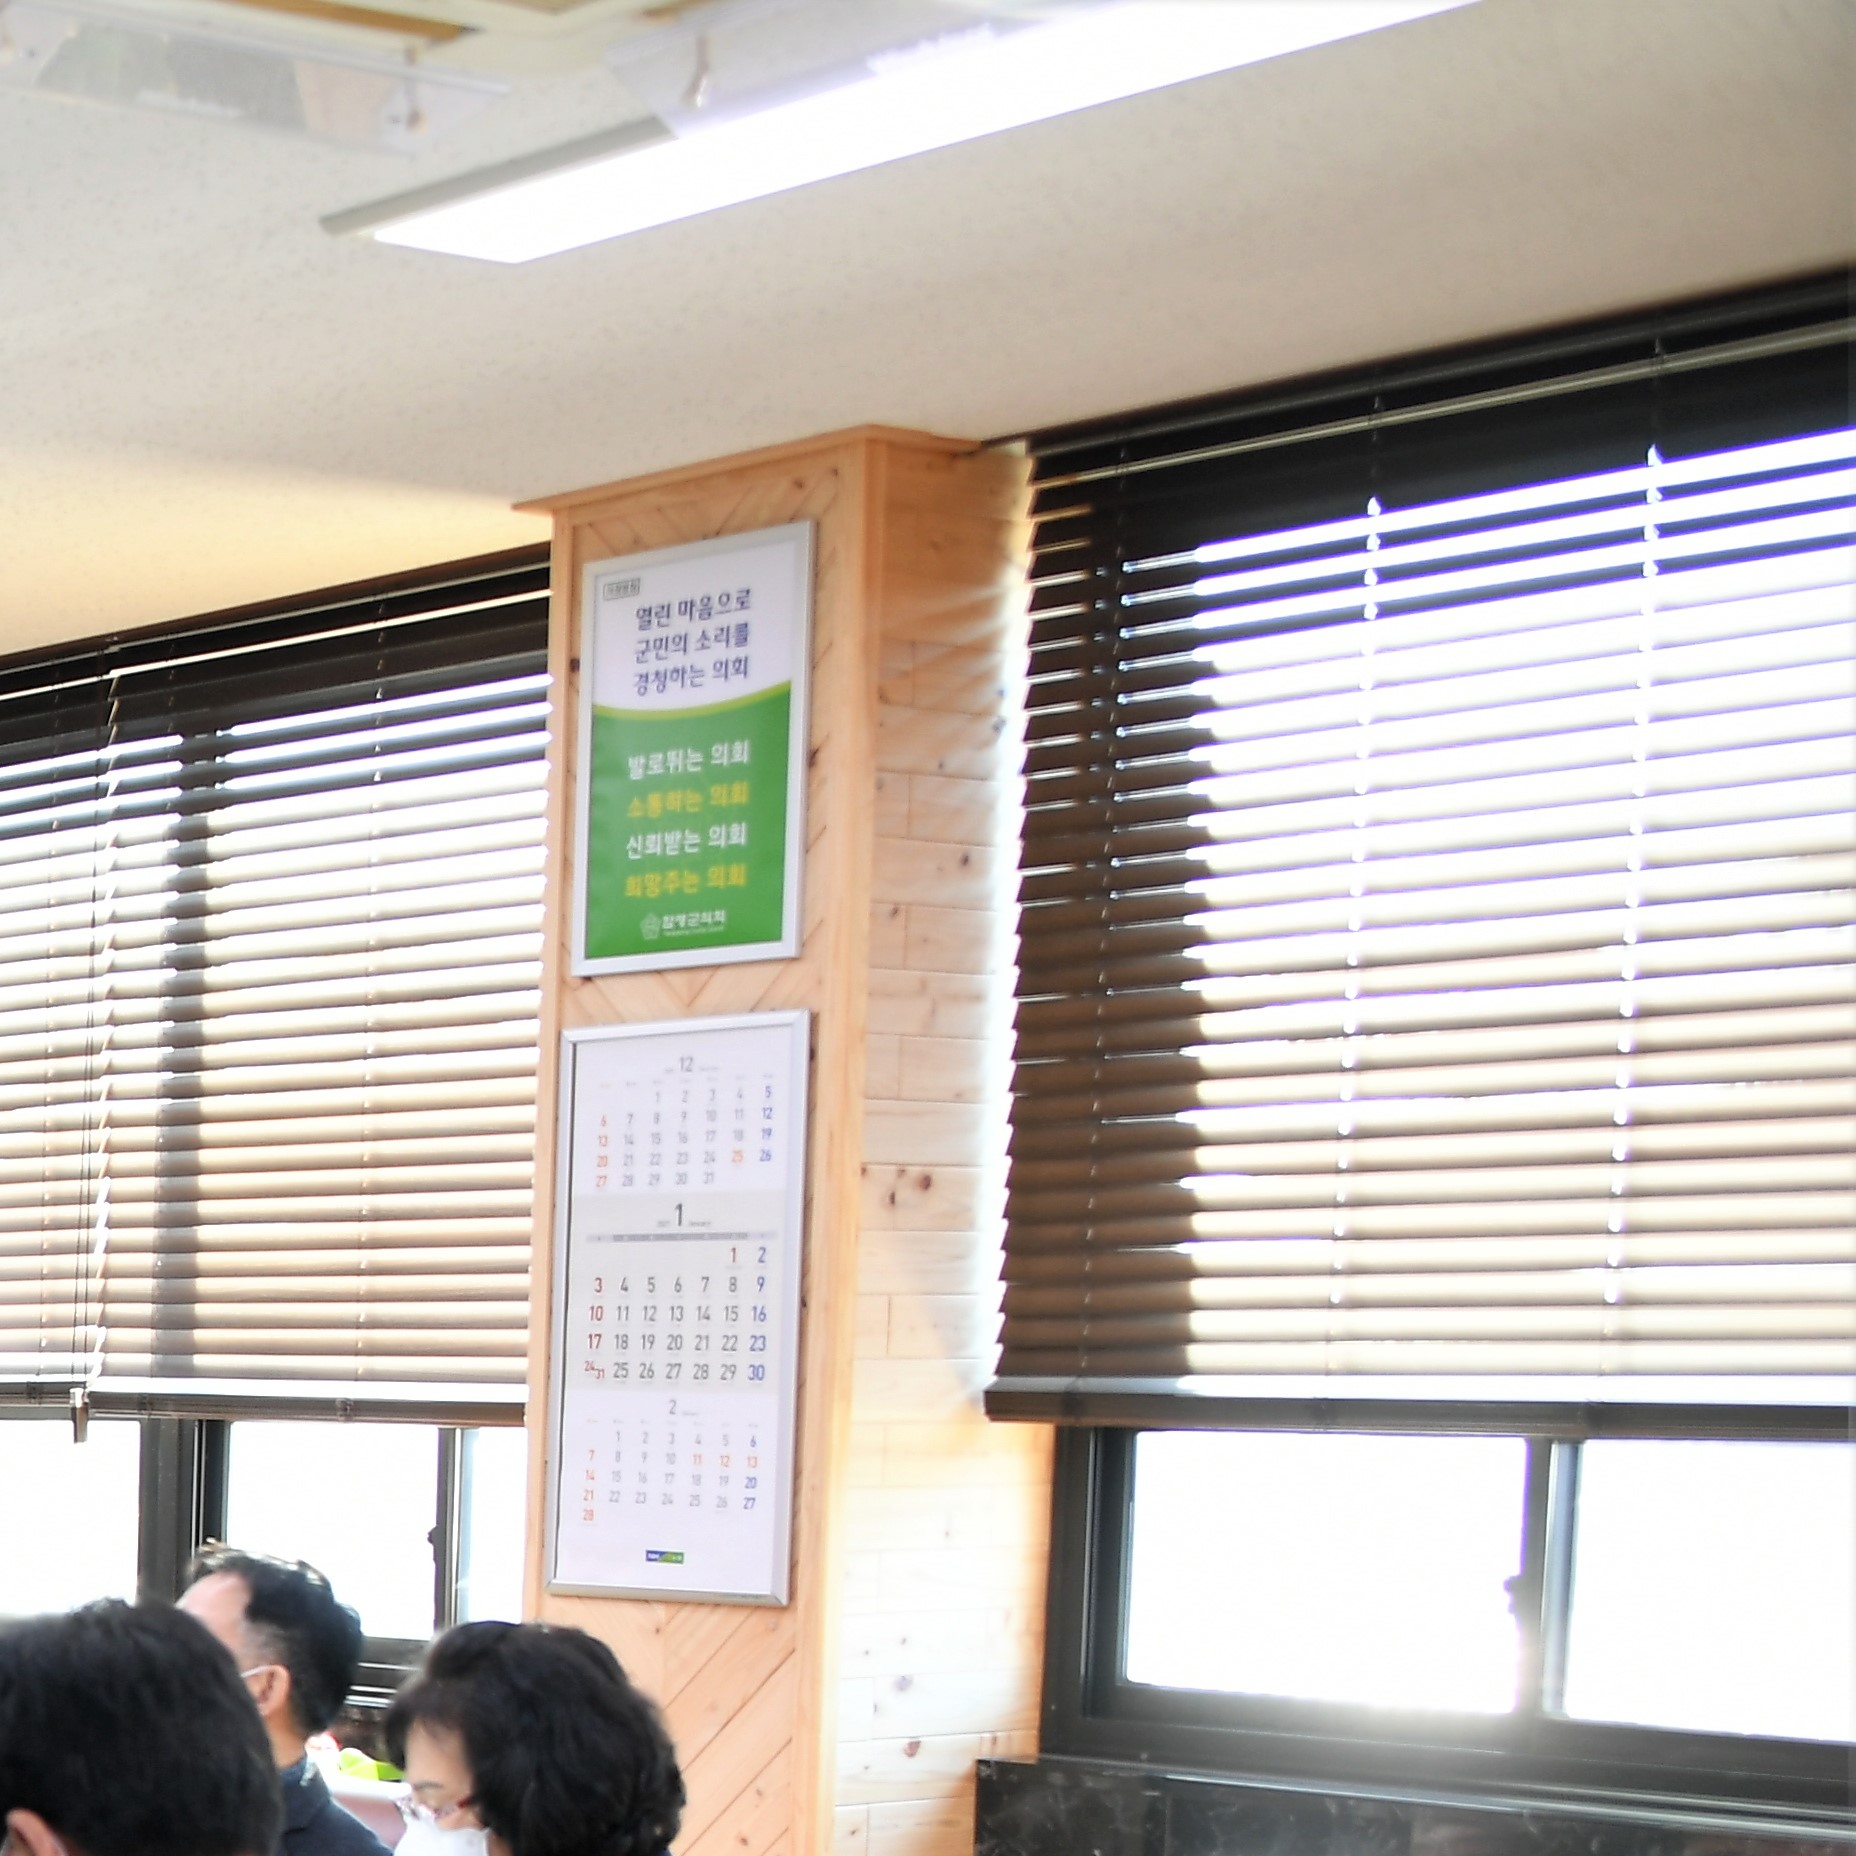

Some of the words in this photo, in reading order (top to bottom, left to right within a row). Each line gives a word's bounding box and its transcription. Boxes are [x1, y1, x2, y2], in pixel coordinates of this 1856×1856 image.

[636, 602, 671, 631] 열린
[678, 588, 751, 622] 마음으로
[635, 632, 688, 664] 군민의
[694, 622, 749, 651] 소리를
[634, 664, 705, 697] 경청하는
[712, 655, 749, 681] 의회
[627, 748, 703, 780] 발로뛰는
[711, 739, 749, 766] 의회
[710, 780, 749, 806] 의회
[626, 828, 700, 859] 신뢰받는
[708, 821, 747, 848] 의회
[707, 863, 746, 889] 의회
[679, 1056, 694, 1072] 12
[674, 1203, 683, 1227] 1
[730, 1247, 736, 1263] 1
[758, 1247, 766, 1263] 2
[594, 1277, 602, 1293] 3
[620, 1277, 629, 1293] 4
[647, 1277, 656, 1293] 5
[674, 1277, 682, 1293] 6
[701, 1276, 710, 1292] 7
[728, 1276, 737, 1293] 8
[757, 1276, 765, 1292] 9
[589, 1306, 603, 1321] 10
[617, 1306, 629, 1321] 11
[643, 1306, 657, 1322] 12
[670, 1306, 684, 1322] 13
[697, 1306, 711, 1322] 14
[724, 1306, 739, 1322] 15
[752, 1306, 767, 1322] 16
[588, 1334, 602, 1349] 17
[614, 1334, 629, 1350] 18
[641, 1334, 655, 1350] 19
[666, 1335, 683, 1350] 20
[694, 1335, 709, 1351] 21
[721, 1335, 738, 1352] 22
[749, 1335, 766, 1352] 23
[613, 1362, 629, 1379] 25
[639, 1363, 655, 1379] 26
[665, 1363, 682, 1380] 27
[693, 1364, 709, 1380] 28
[720, 1364, 737, 1380] 29
[748, 1365, 765, 1381] 30
[669, 1399, 677, 1415] 2
